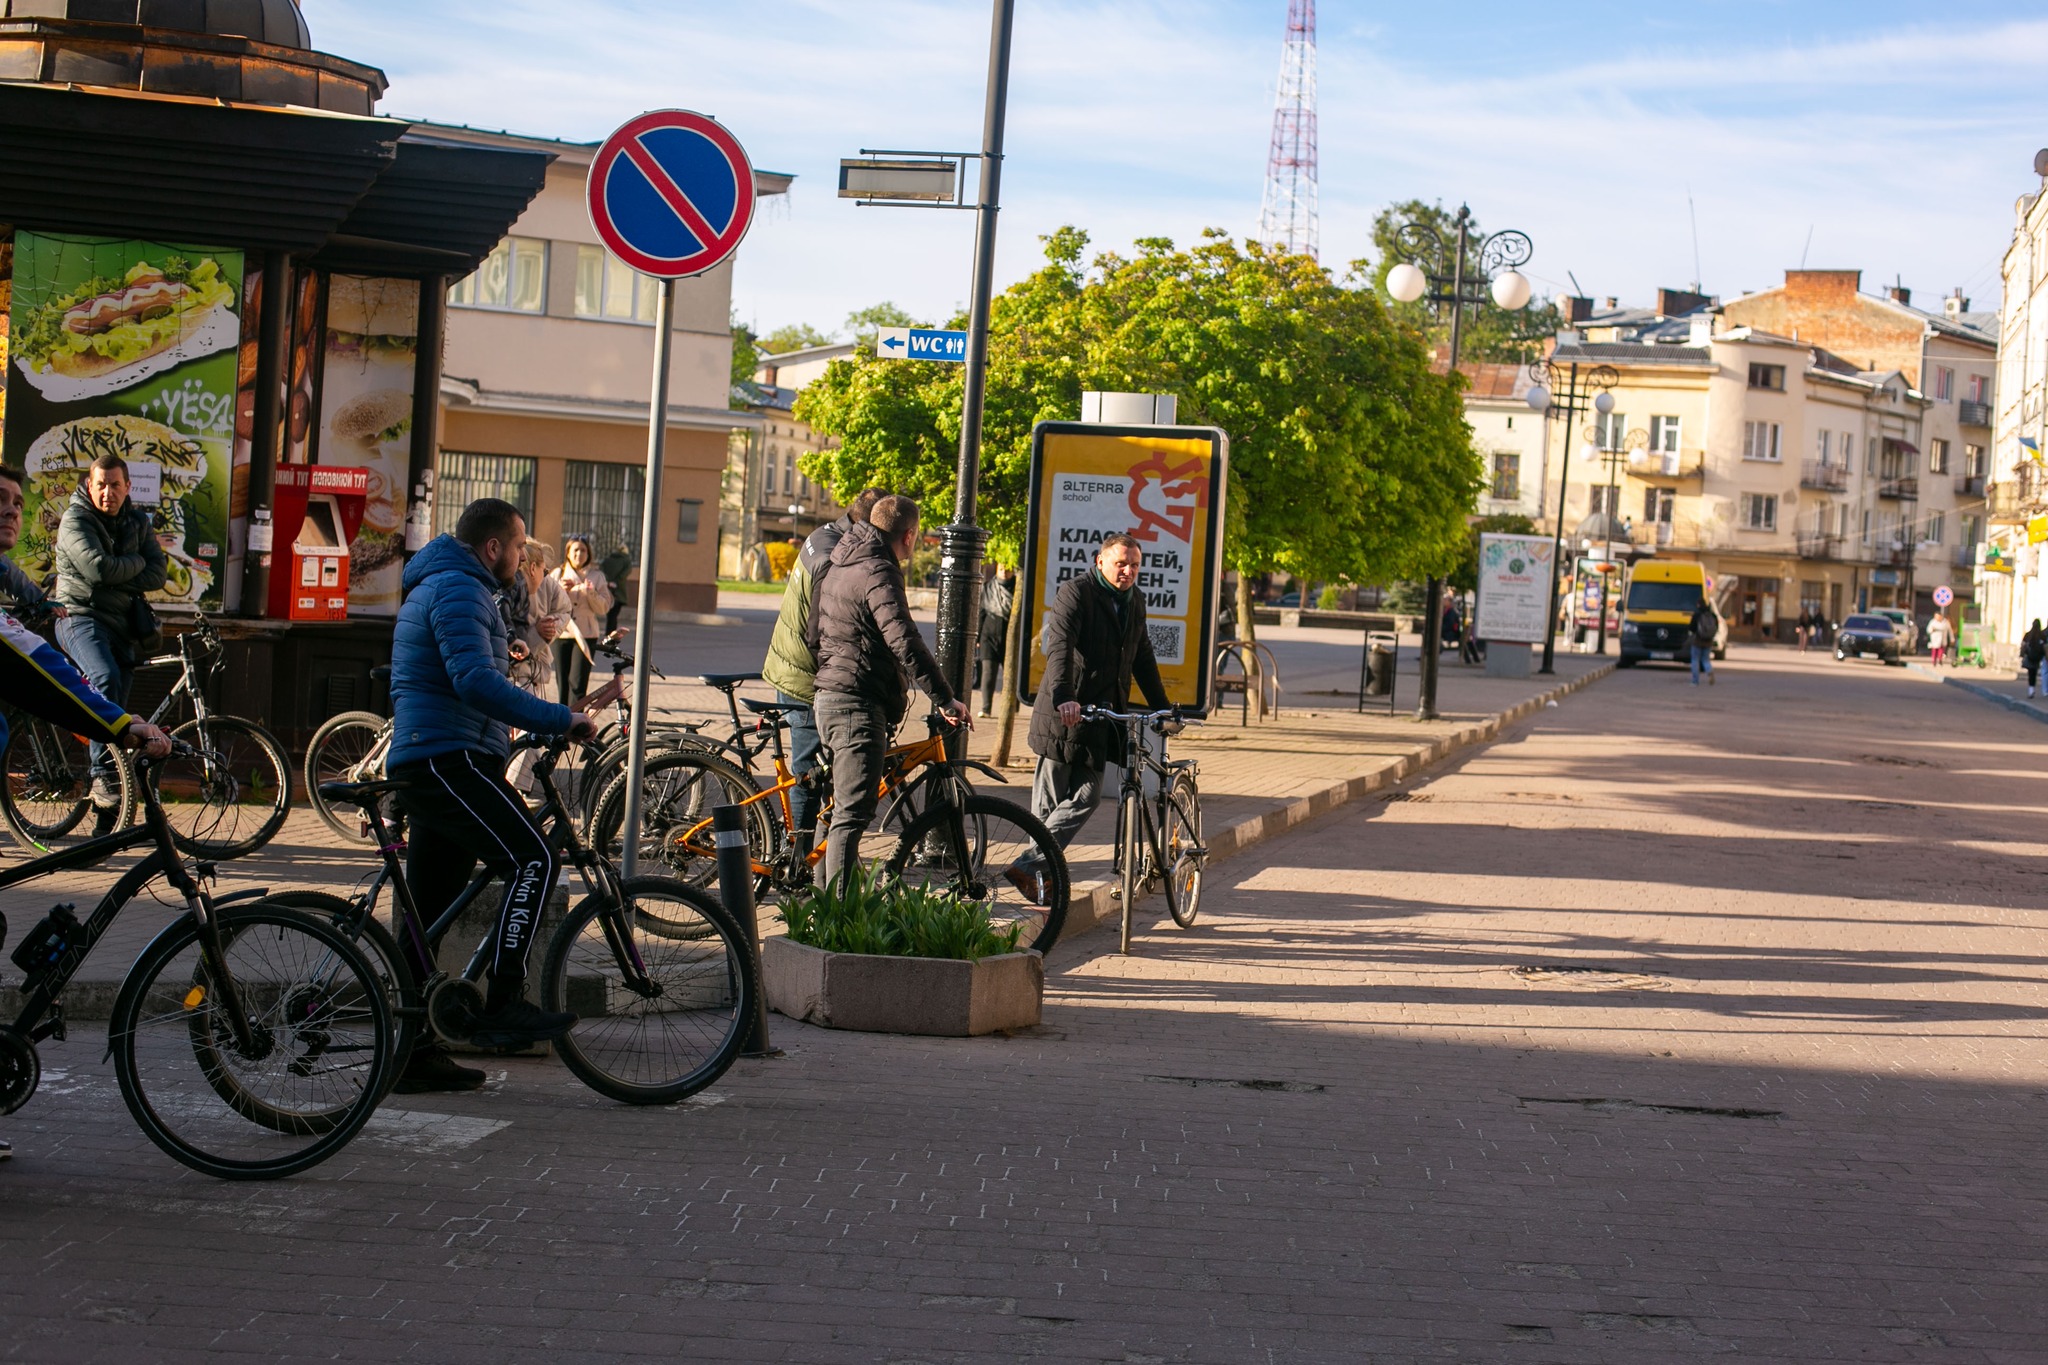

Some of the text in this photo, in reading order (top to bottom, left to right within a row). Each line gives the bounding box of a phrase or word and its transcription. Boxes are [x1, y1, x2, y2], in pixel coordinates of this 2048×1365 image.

[911, 336, 943, 353] WC
[297, 471, 309, 487] ТУТ
[354, 473, 367, 489] ТУТ
[1062, 493, 1092, 502] school
[1058, 547, 1087, 563] НА
[505, 860, 542, 949] Calvin Klein
